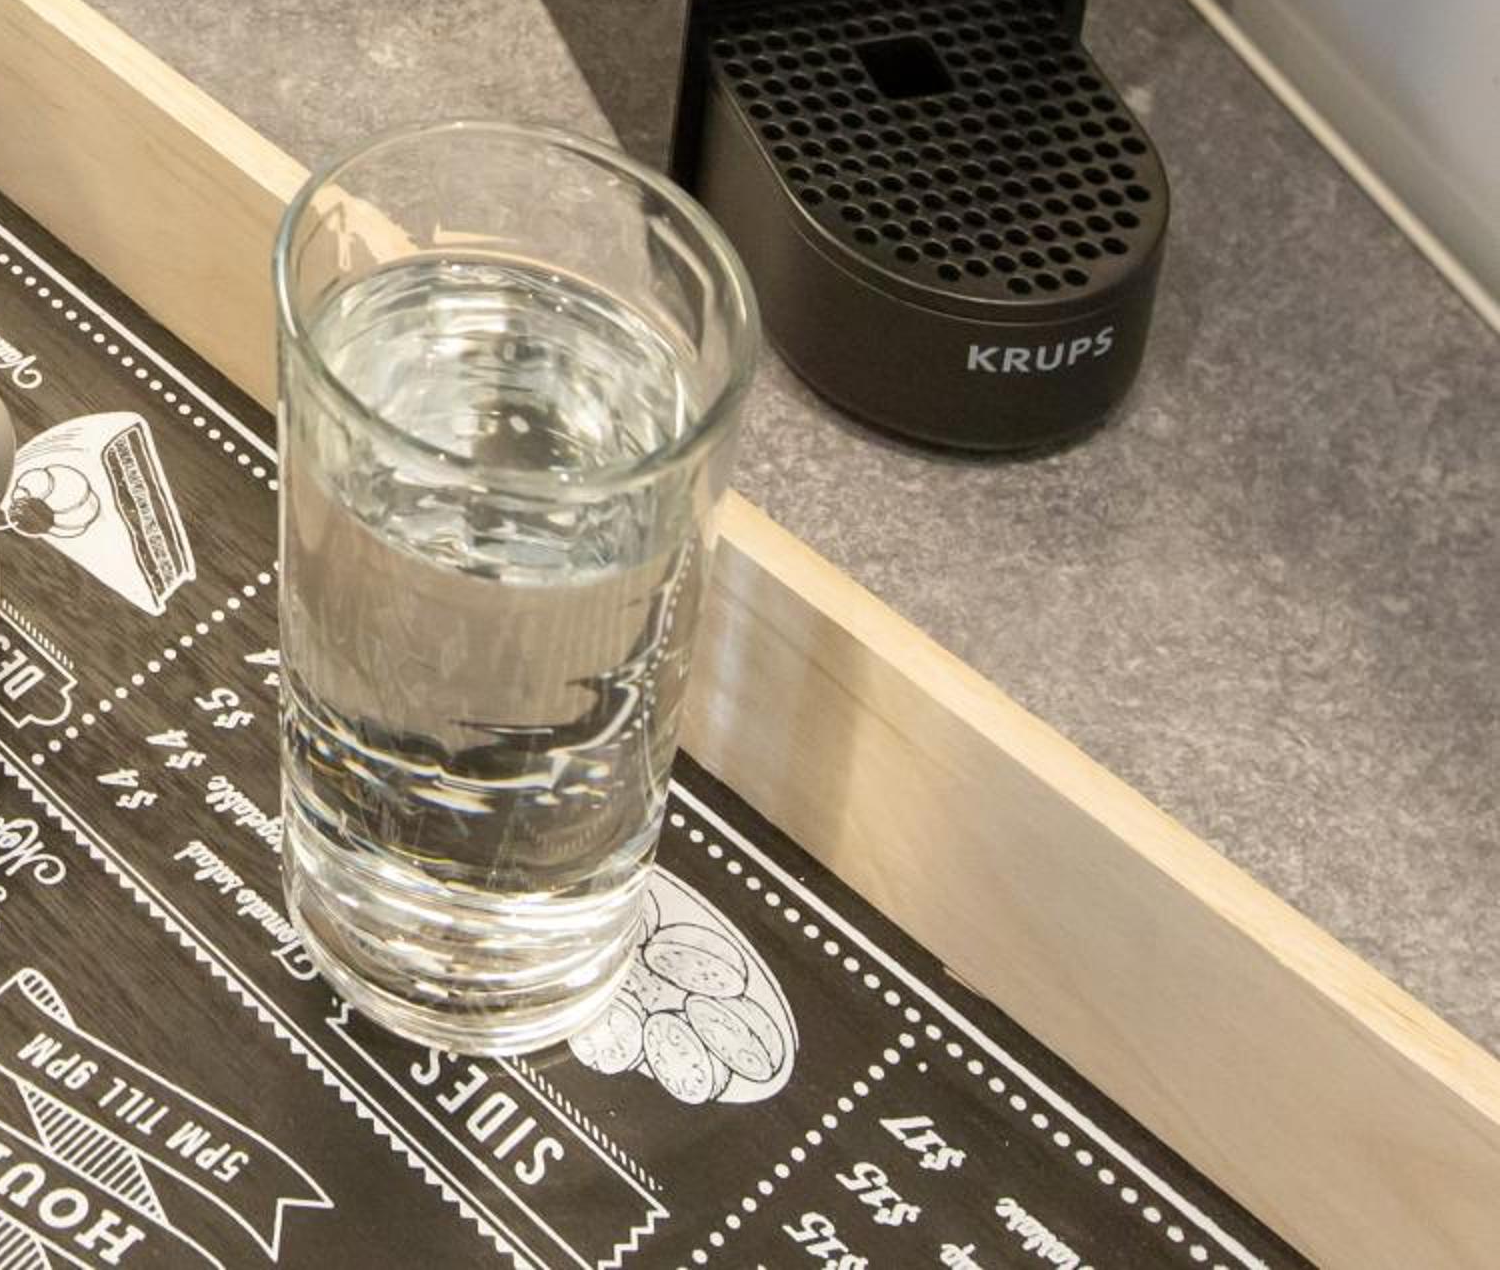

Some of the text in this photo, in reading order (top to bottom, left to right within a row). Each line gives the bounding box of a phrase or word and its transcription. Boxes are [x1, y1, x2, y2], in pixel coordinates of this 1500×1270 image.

[968, 326, 1113, 372] KRUPS
[196, 687, 254, 729] $5
[147, 730, 206, 770] $4
[97, 769, 157, 809] $4
[174, 840, 243, 894] salad
[17, 1033, 251, 1184] 5PM TILL 9PM
[878, 1114, 967, 1171] $17
[835, 1162, 921, 1227] $15
